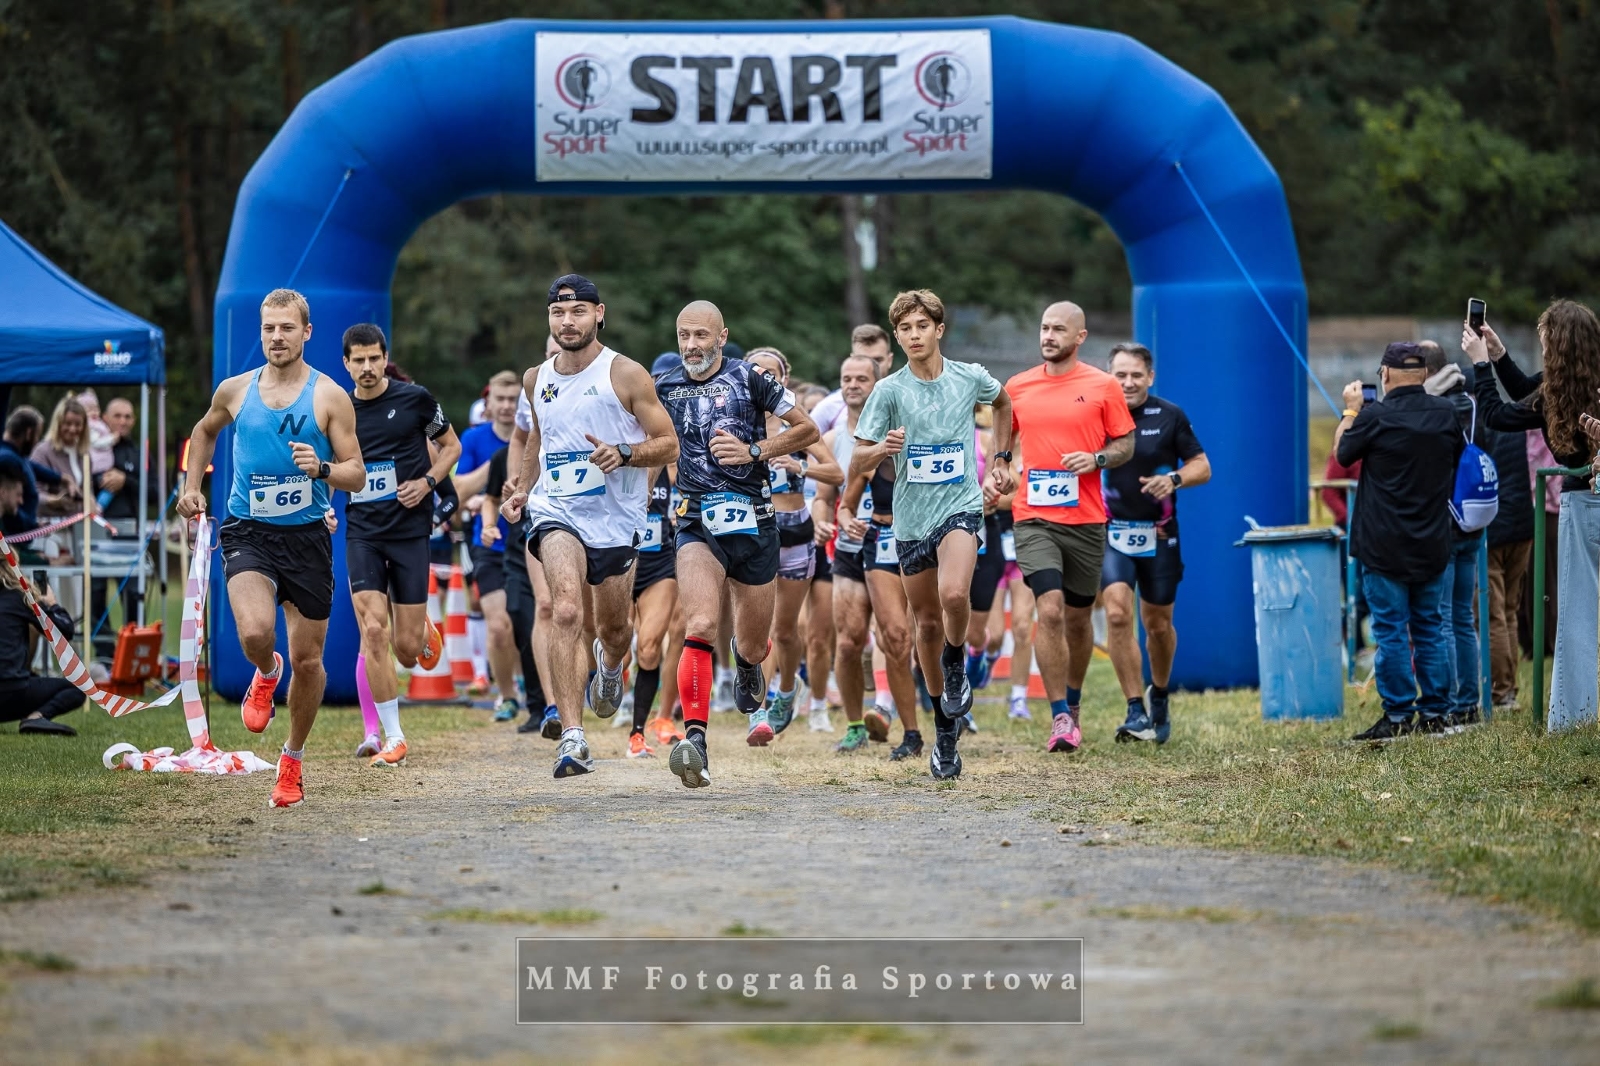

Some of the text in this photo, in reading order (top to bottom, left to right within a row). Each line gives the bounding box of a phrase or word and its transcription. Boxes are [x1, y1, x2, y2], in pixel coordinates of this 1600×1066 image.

[629, 54, 898, 124] START
[553, 111, 622, 139] Super
[914, 110, 983, 137] Super
[543, 131, 607, 159] Sport
[636, 135, 888, 158] www.super-sport.com.pl
[903, 130, 968, 157] Sport
[668, 385, 730, 401] SEBASTIAN
[940, 446, 961, 454] 2026
[930, 460, 955, 473] 36
[285, 475, 308, 484] 2026
[368, 477, 386, 491] 16
[574, 468, 588, 484] 7
[275, 490, 303, 506] 66
[1047, 484, 1070, 497] 64
[724, 508, 748, 522] 37
[1127, 534, 1147, 547] 59
